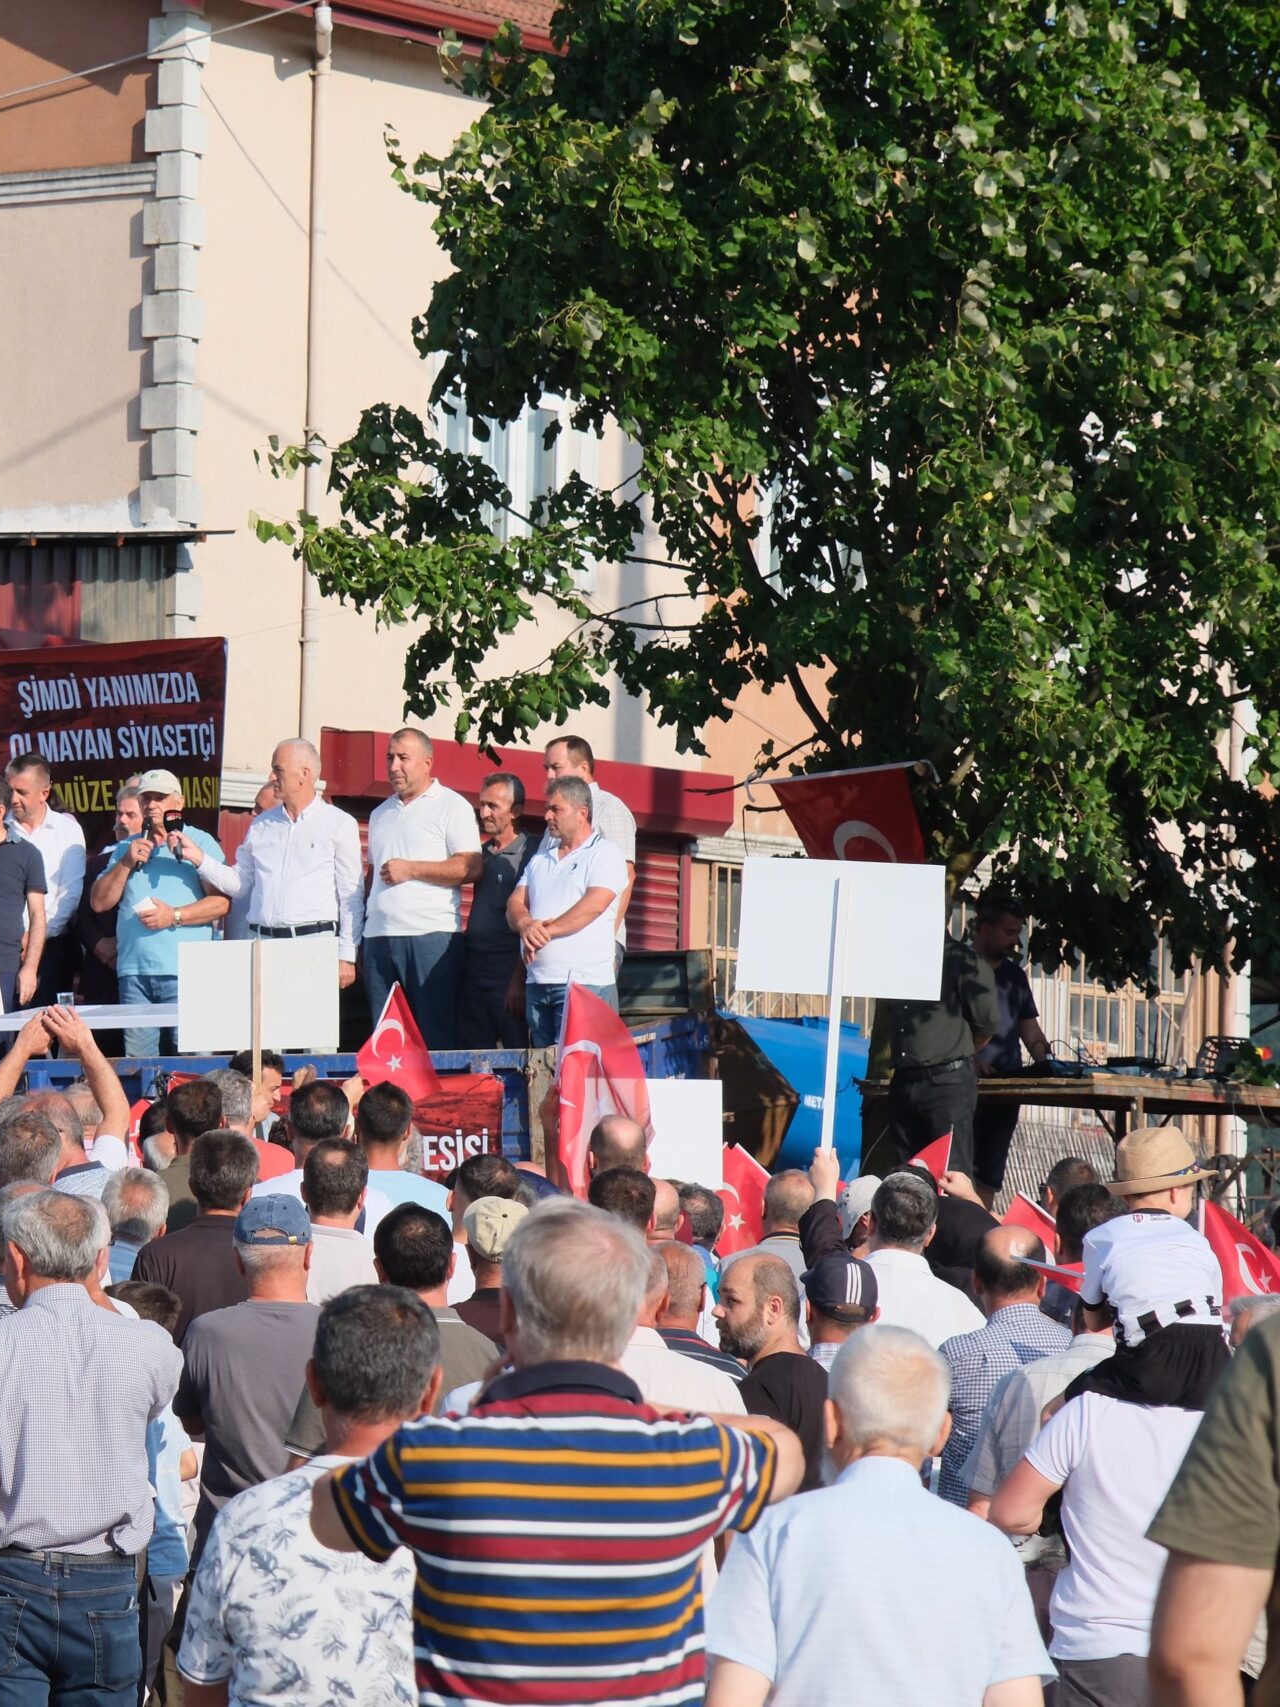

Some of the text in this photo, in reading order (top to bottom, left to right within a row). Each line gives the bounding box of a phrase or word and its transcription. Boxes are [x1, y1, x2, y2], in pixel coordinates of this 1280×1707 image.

[17, 671, 200, 718] ŞİMDİ YANIMIZDA
[9, 717, 215, 763] OLMAYAN SİYASETÇİ
[53, 776, 116, 813] MÜZE
[422, 1127, 488, 1171] ESİSİ
